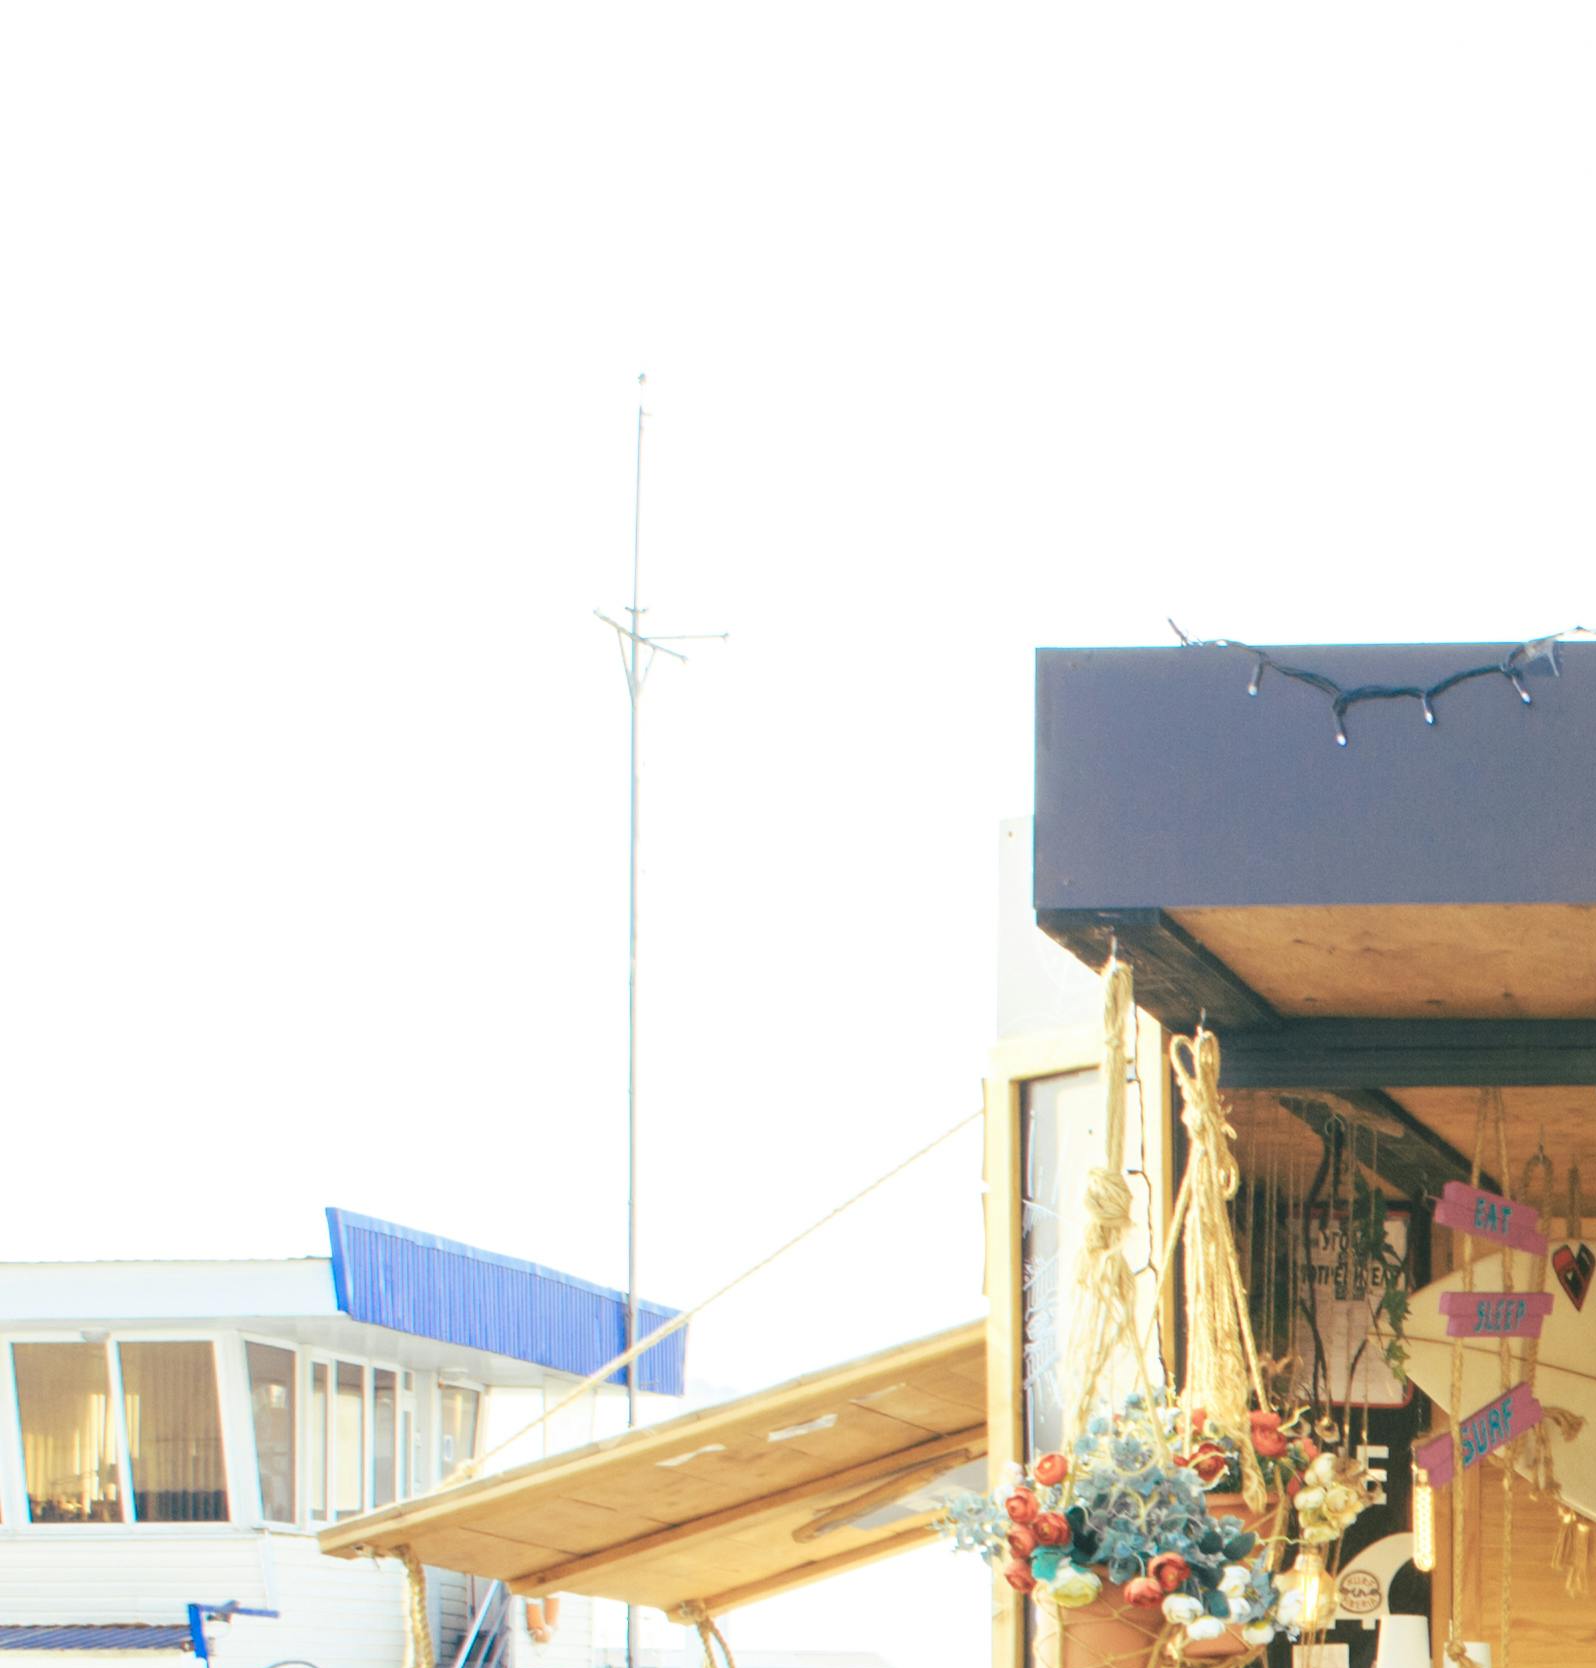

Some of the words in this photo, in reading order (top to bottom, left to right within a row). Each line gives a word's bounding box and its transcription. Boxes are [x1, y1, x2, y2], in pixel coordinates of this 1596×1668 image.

[1473, 1196, 1513, 1235] EAT
[1473, 1298, 1528, 1333] SLEEP
[1460, 1396, 1516, 1469] SURF
